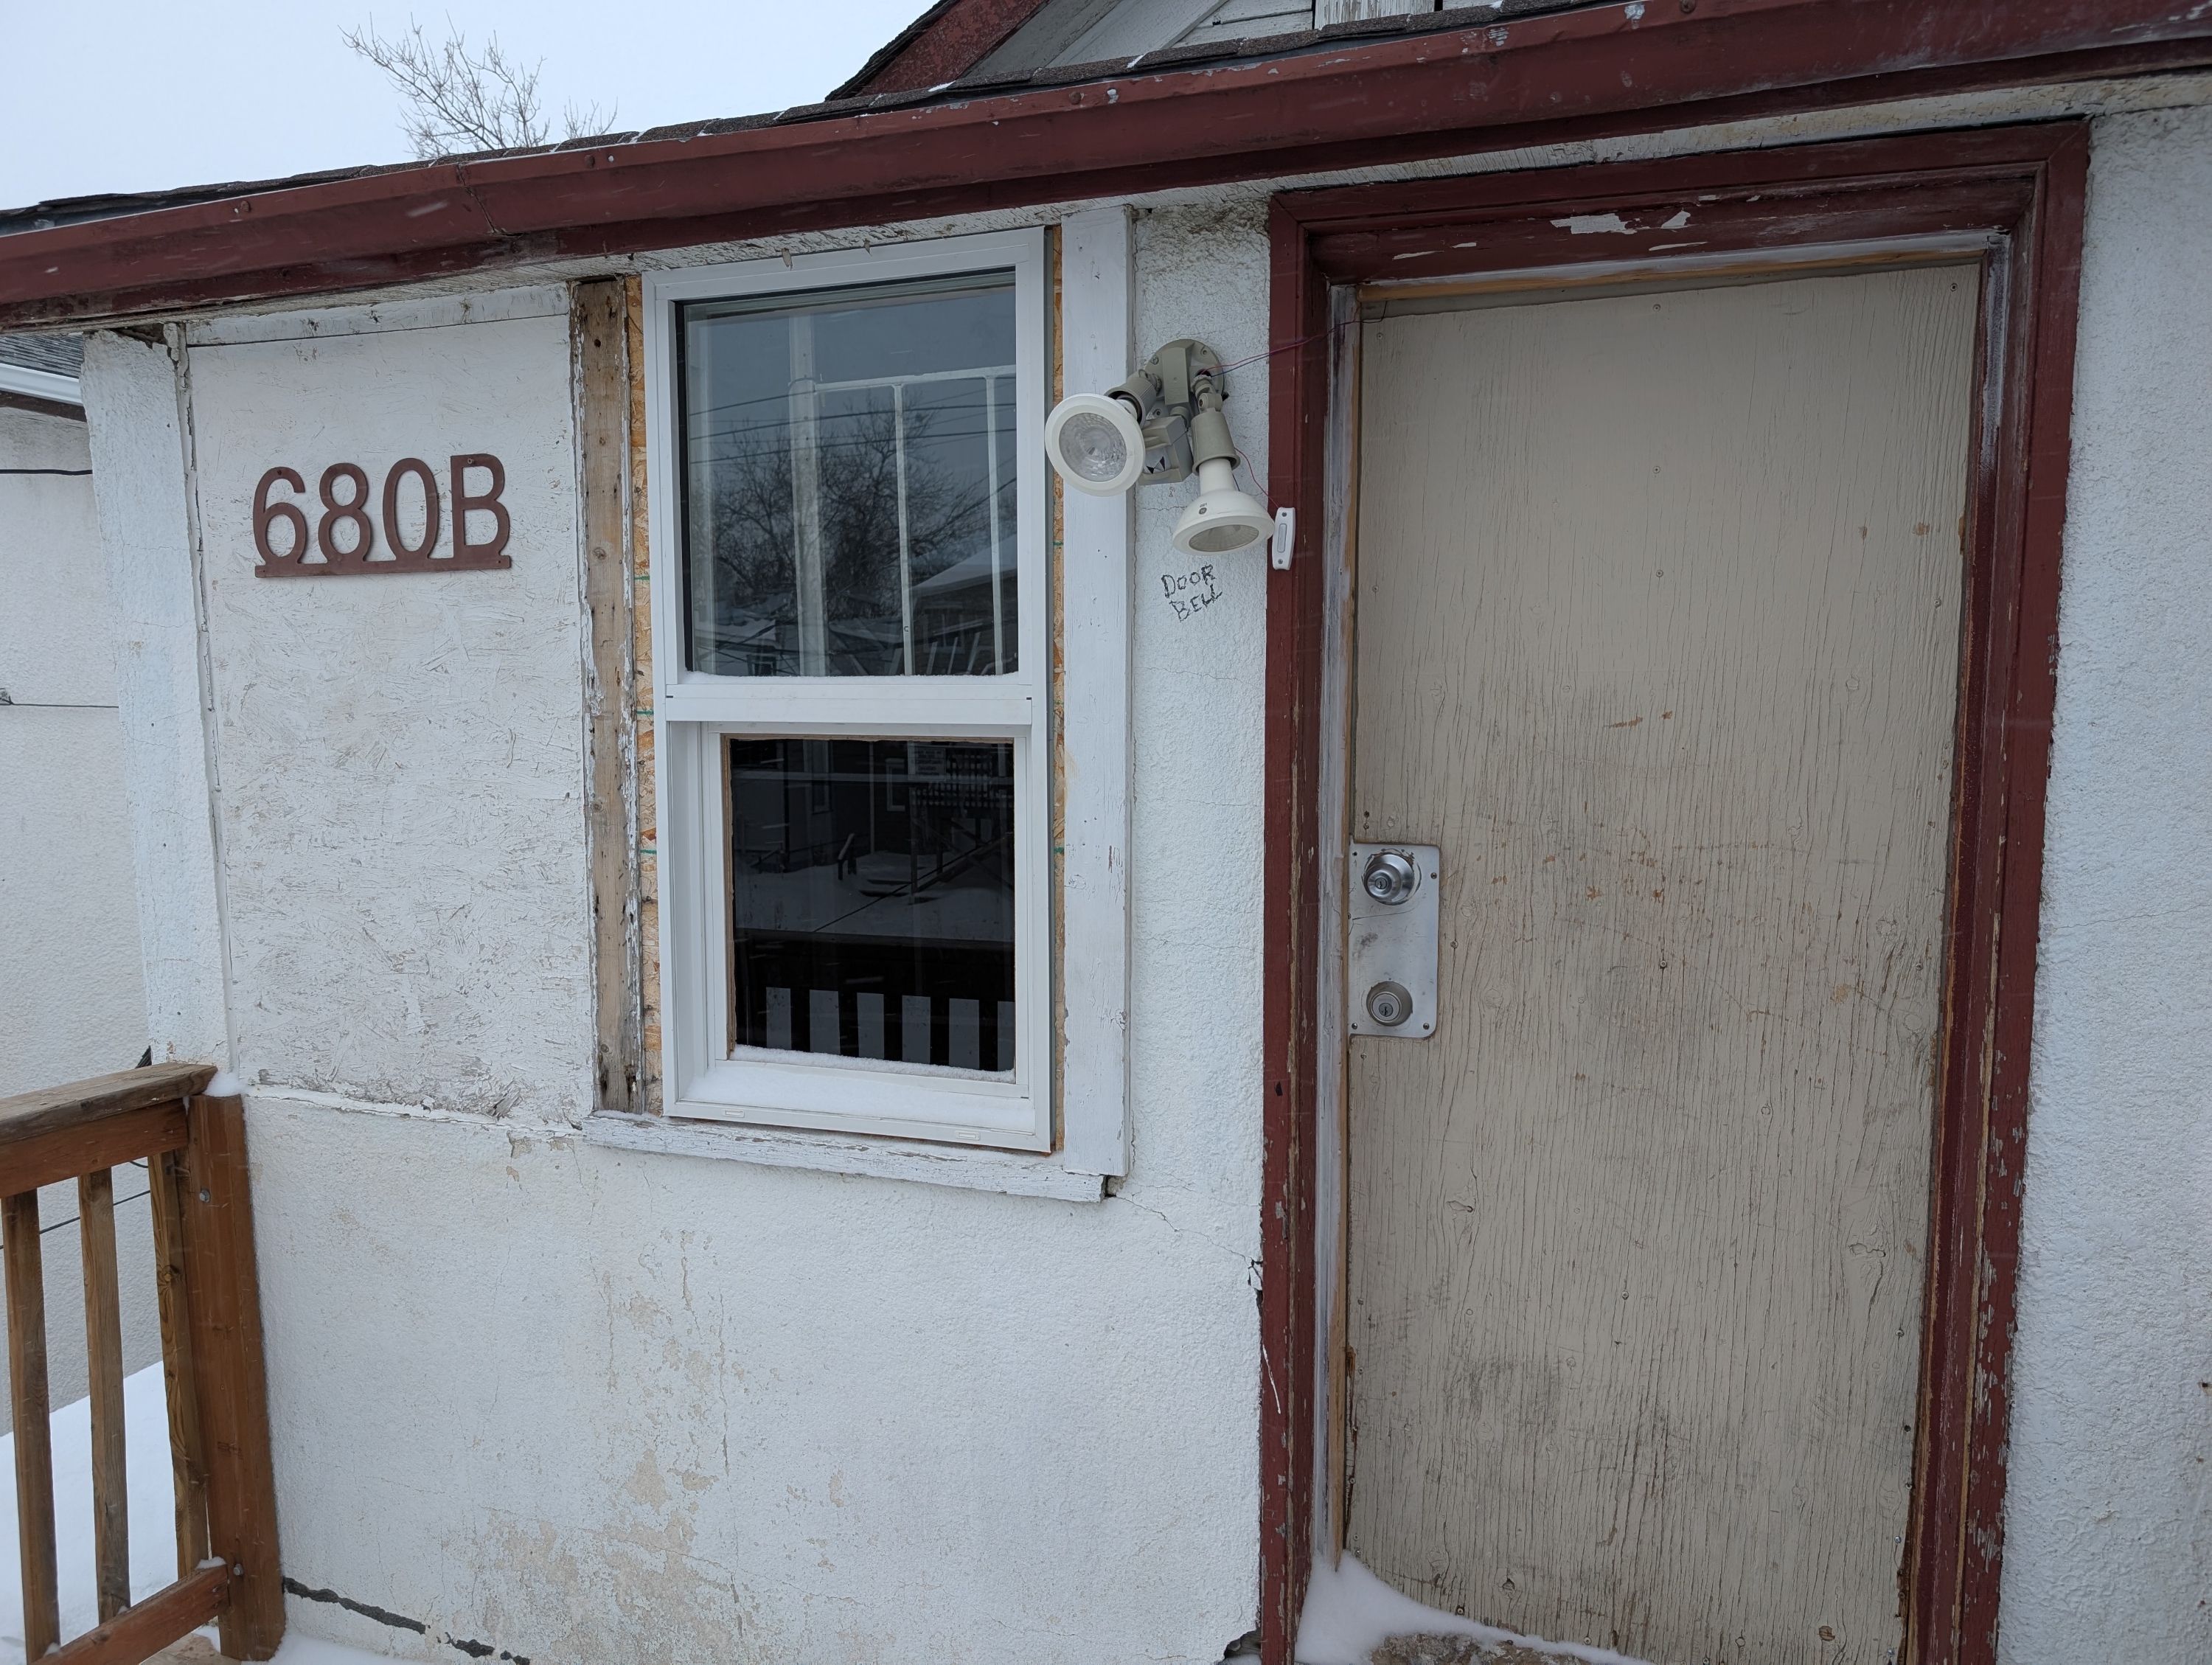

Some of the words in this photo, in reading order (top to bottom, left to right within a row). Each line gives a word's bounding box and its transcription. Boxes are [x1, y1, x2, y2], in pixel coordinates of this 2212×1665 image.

[253, 453, 510, 571] 680B
[1161, 564, 1217, 598] DOOR
[1169, 583, 1223, 622] BELL
